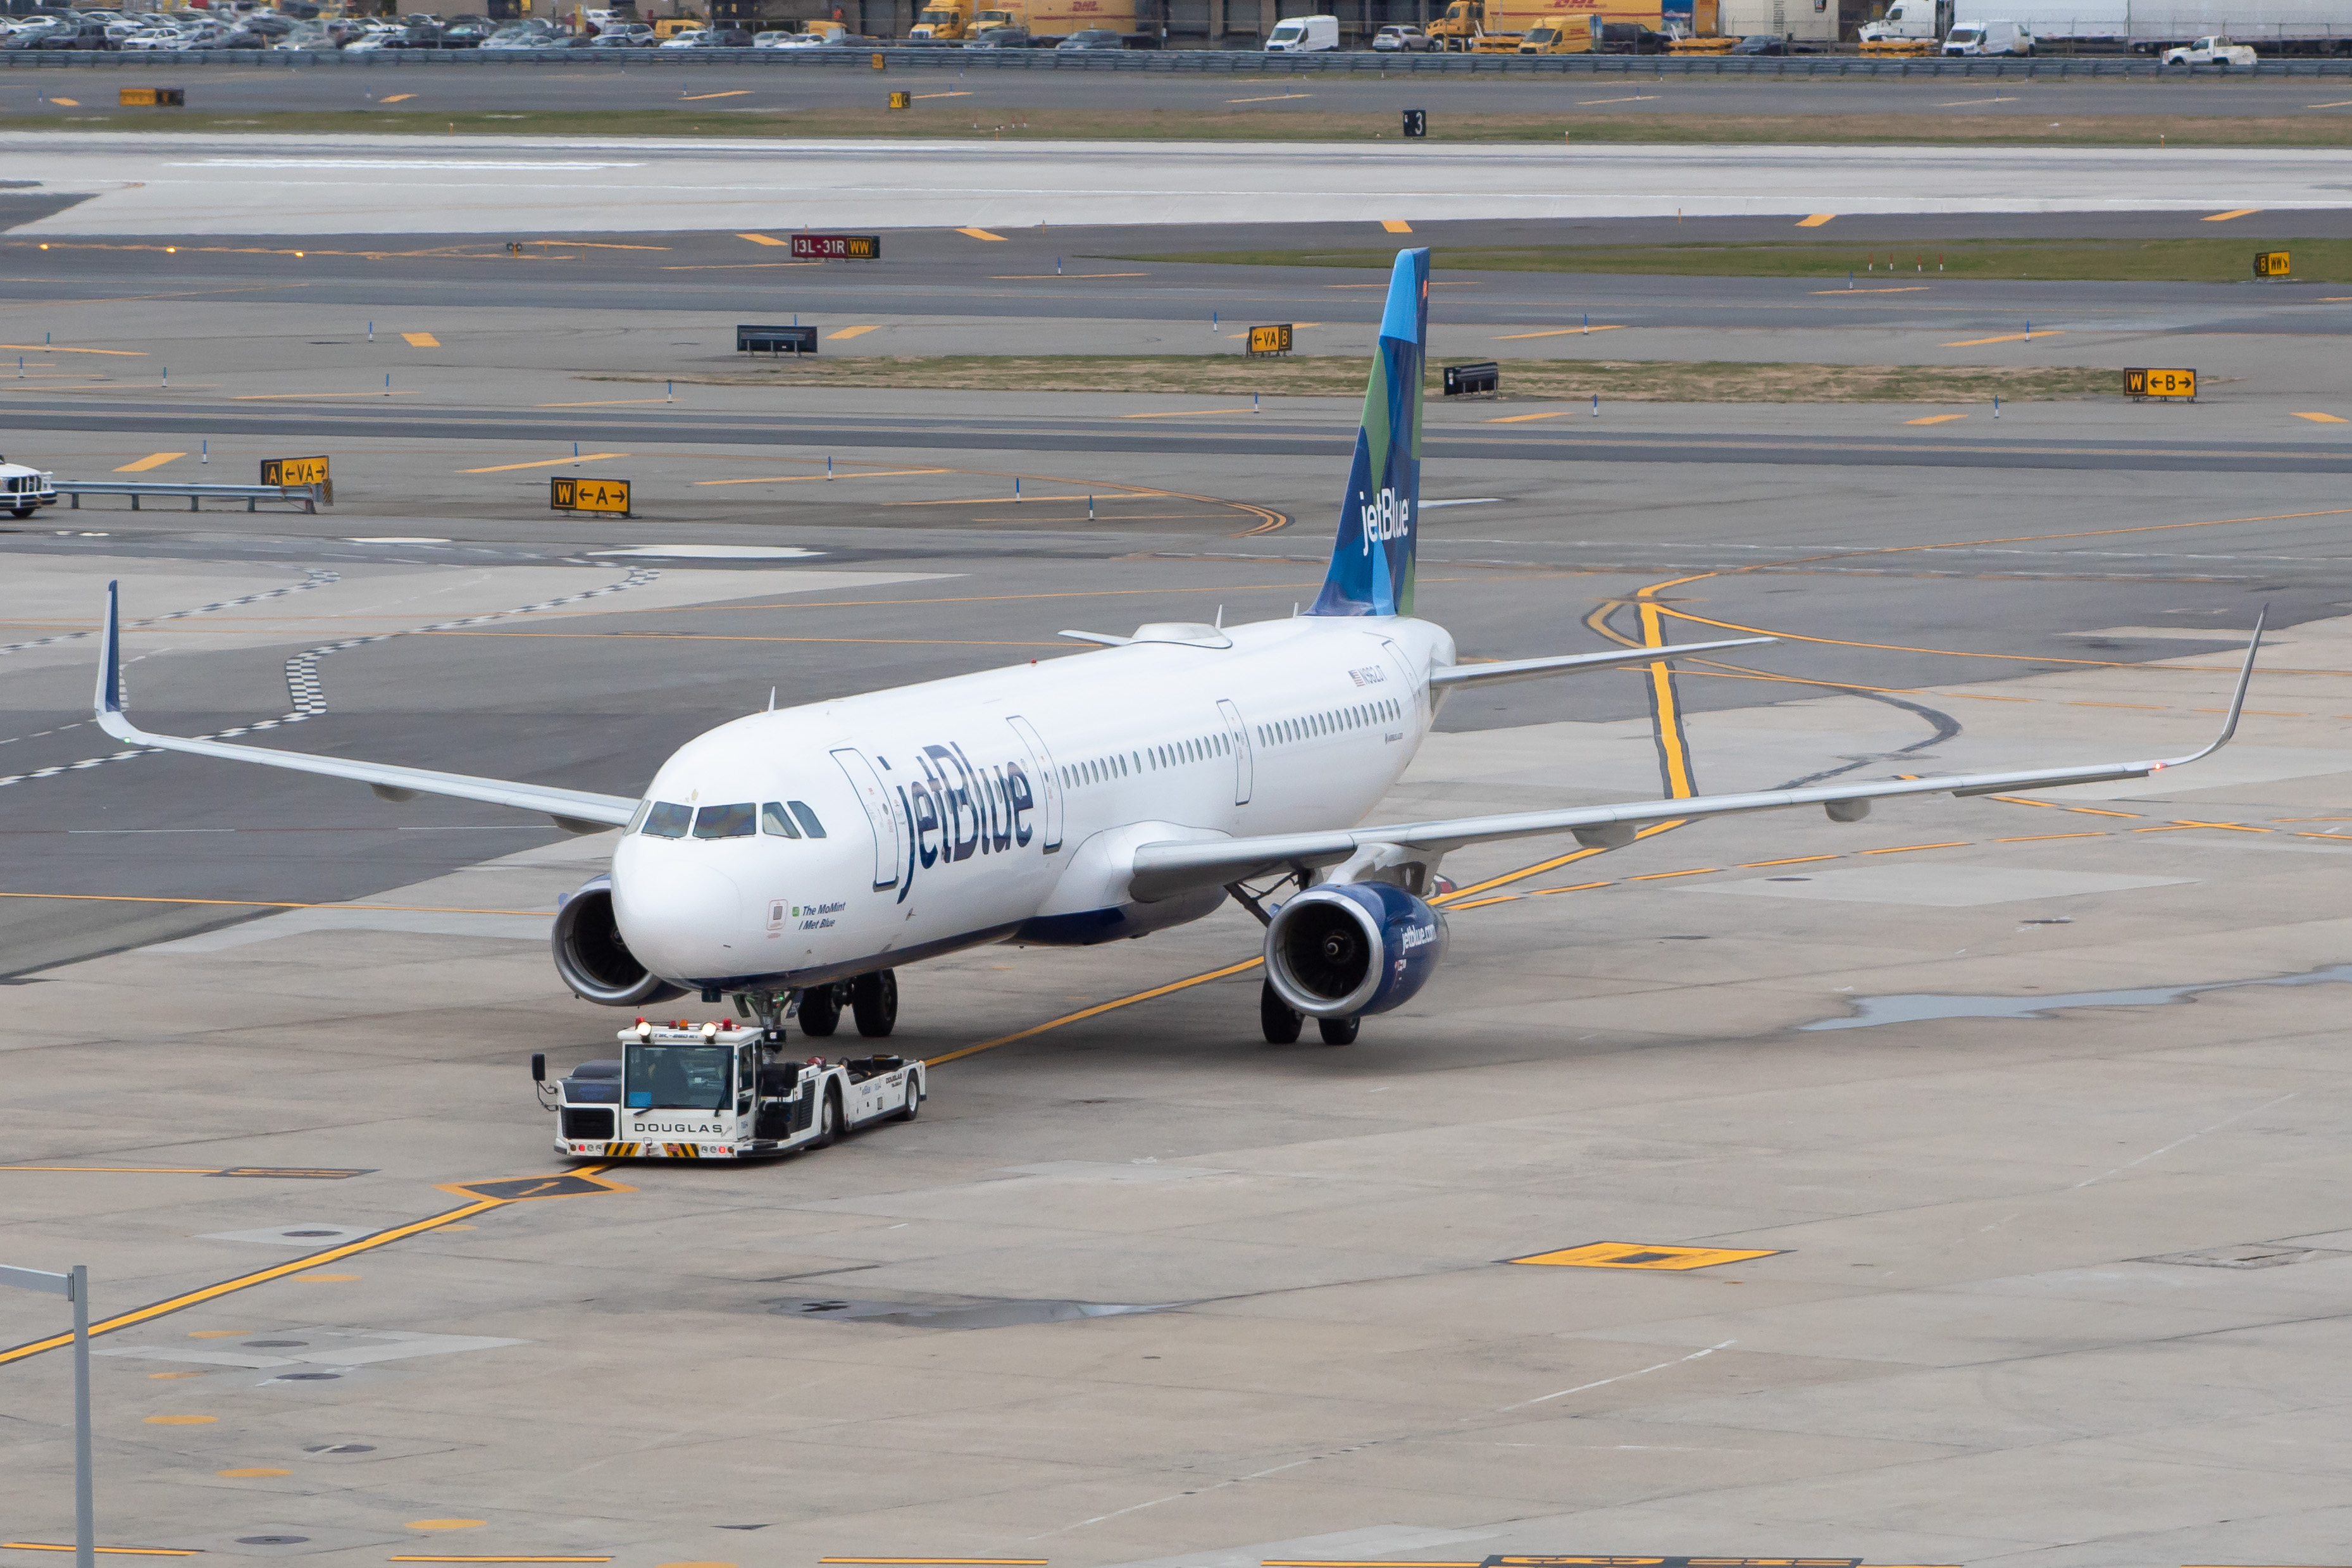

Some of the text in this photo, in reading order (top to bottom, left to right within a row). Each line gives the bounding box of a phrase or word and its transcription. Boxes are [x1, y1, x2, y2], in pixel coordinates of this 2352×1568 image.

[1416, 112, 1423, 135] 3
[794, 239, 869, 254] 13L-31R WW
[1264, 330, 1288, 346] VA B
[2130, 374, 2176, 390] W B
[269, 463, 314, 484] A VA
[558, 484, 608, 505] W A
[1359, 487, 1409, 557] jetBlue
[876, 741, 1034, 905] jetBlue
[802, 901, 846, 916] The MoMint
[798, 918, 835, 930] I Met Blue
[1400, 924, 1437, 956] jetblue.com
[634, 1123, 722, 1133] DOUGLAS
